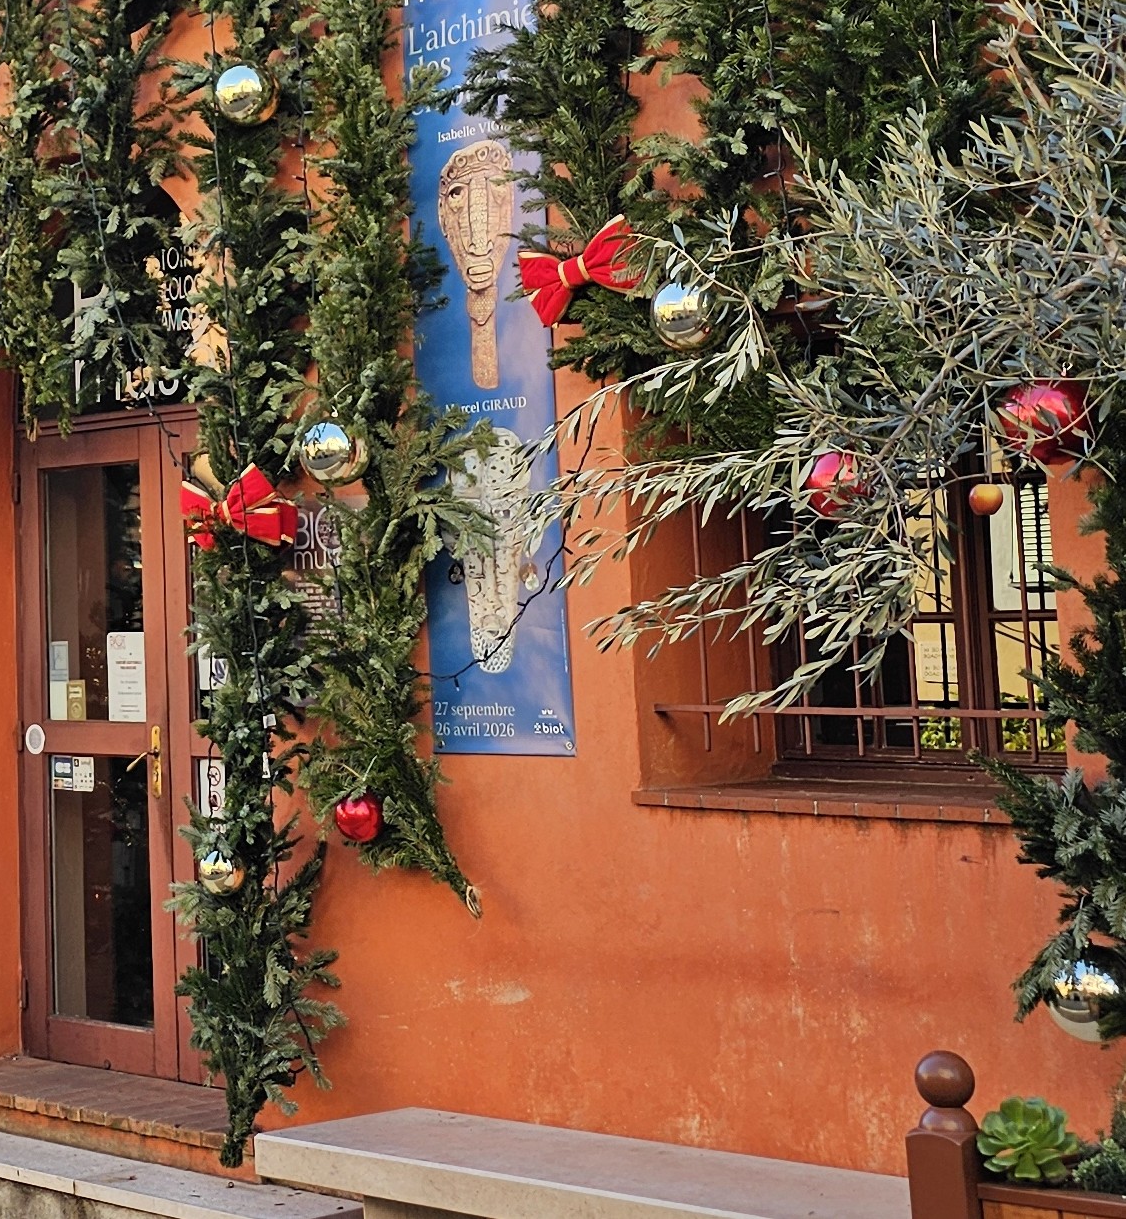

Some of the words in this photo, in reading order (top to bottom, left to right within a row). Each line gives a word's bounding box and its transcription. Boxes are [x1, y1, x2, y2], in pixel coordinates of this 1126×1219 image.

[408, 0, 535, 56] L'alchimie
[437, 125, 476, 143] Isabelle
[482, 396, 527, 412] GIRAUD
[435, 701, 449, 716] 27
[451, 702, 515, 720] septembre
[436, 722, 451, 736] 26
[453, 723, 480, 737] avril
[483, 723, 515, 737] 2026
[542, 723, 565, 735] biot
